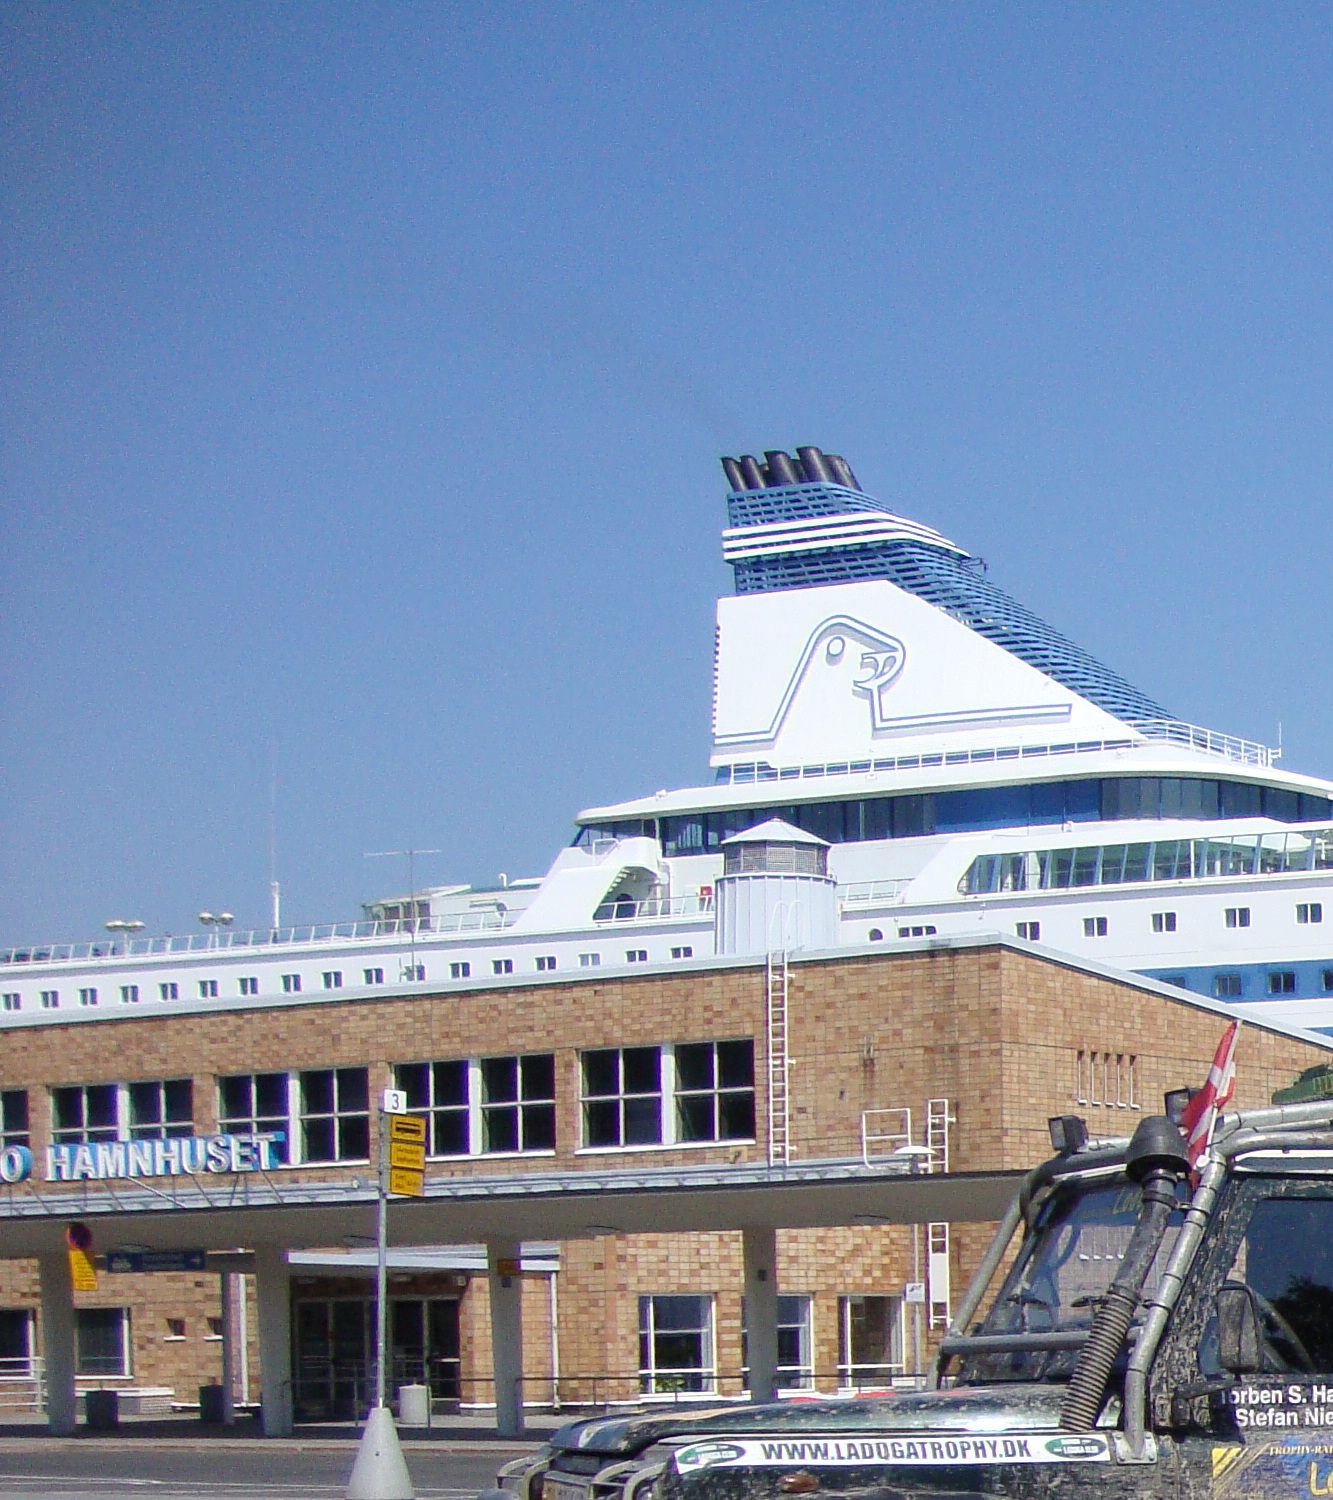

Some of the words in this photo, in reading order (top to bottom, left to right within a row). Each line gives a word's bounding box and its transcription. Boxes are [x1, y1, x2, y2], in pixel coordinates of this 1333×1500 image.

[391, 1093, 399, 1110] 3
[46, 1132, 280, 1181] HAMNHUSET
[1288, 1385, 1307, 1404] S.
[1235, 1408, 1299, 1426] Stefan
[760, 1438, 1032, 1461] WWW.LADOGATROPHY.DK
